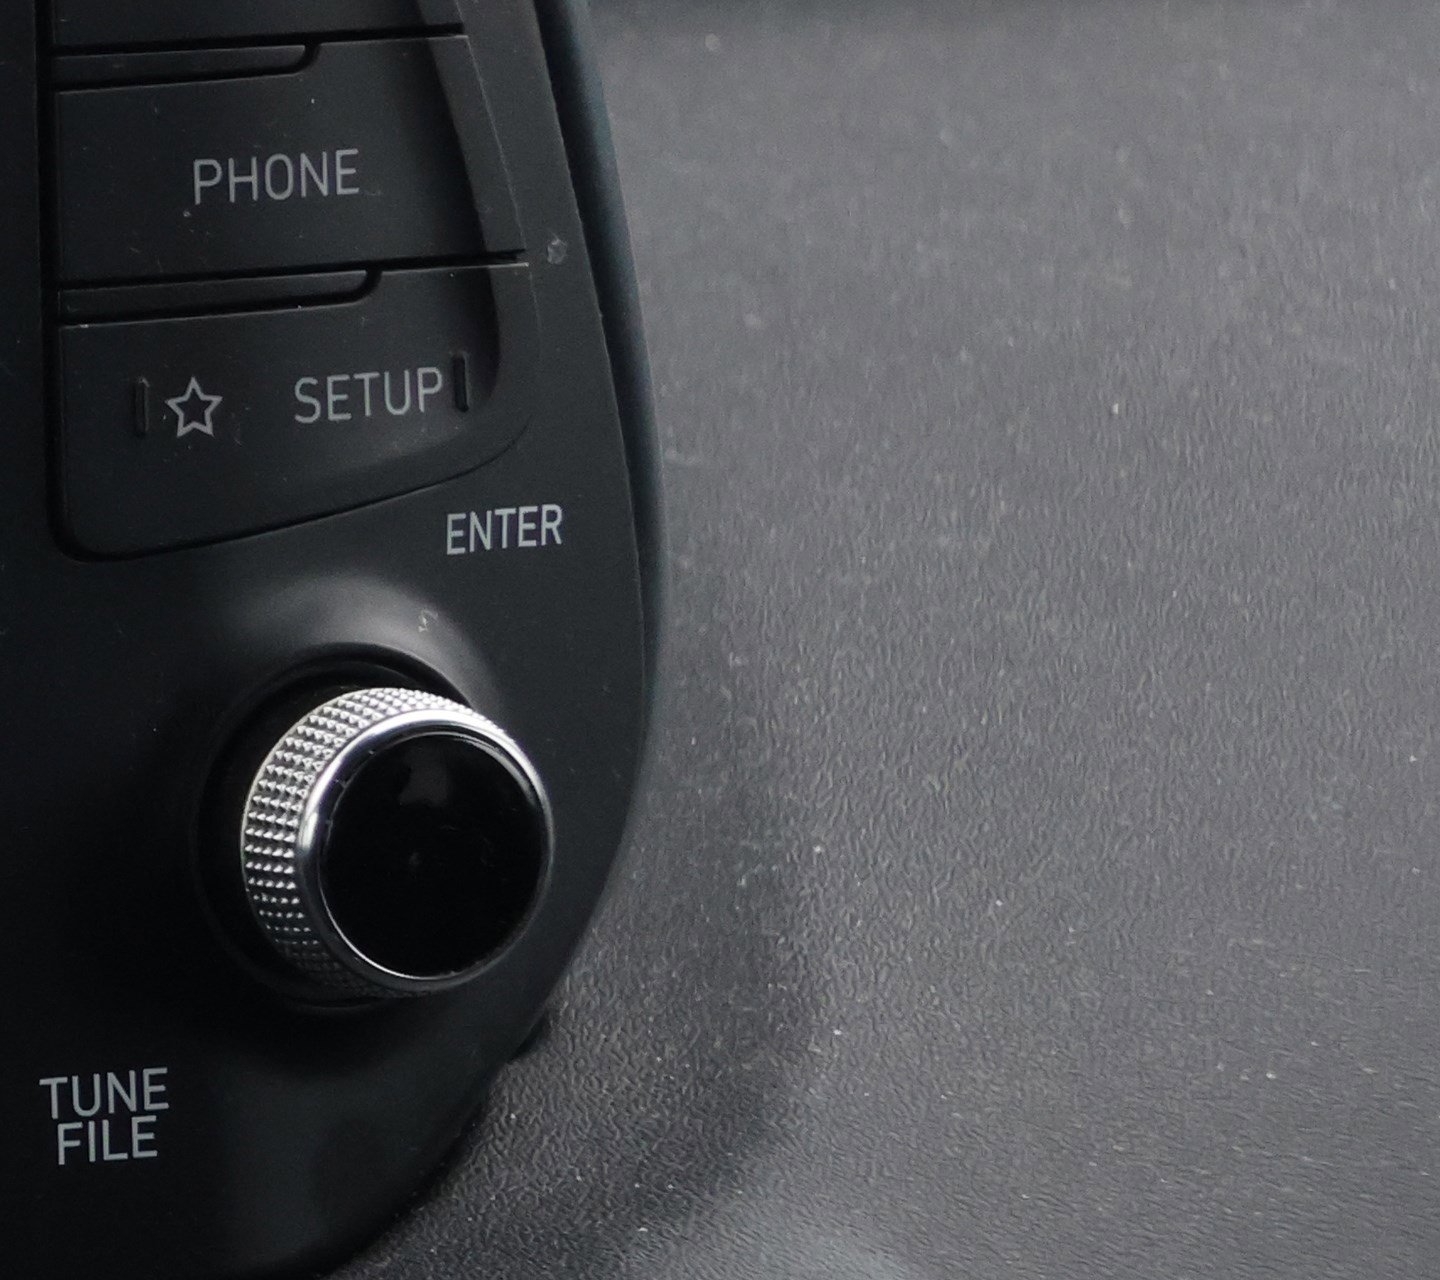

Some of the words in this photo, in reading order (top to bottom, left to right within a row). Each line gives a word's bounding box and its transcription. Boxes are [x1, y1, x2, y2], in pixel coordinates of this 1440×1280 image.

[192, 148, 361, 205] PHONE
[293, 366, 444, 424] SETUP
[445, 503, 564, 555] ENTER
[38, 1066, 170, 1120] TUNE
[57, 1114, 159, 1166] FILE
